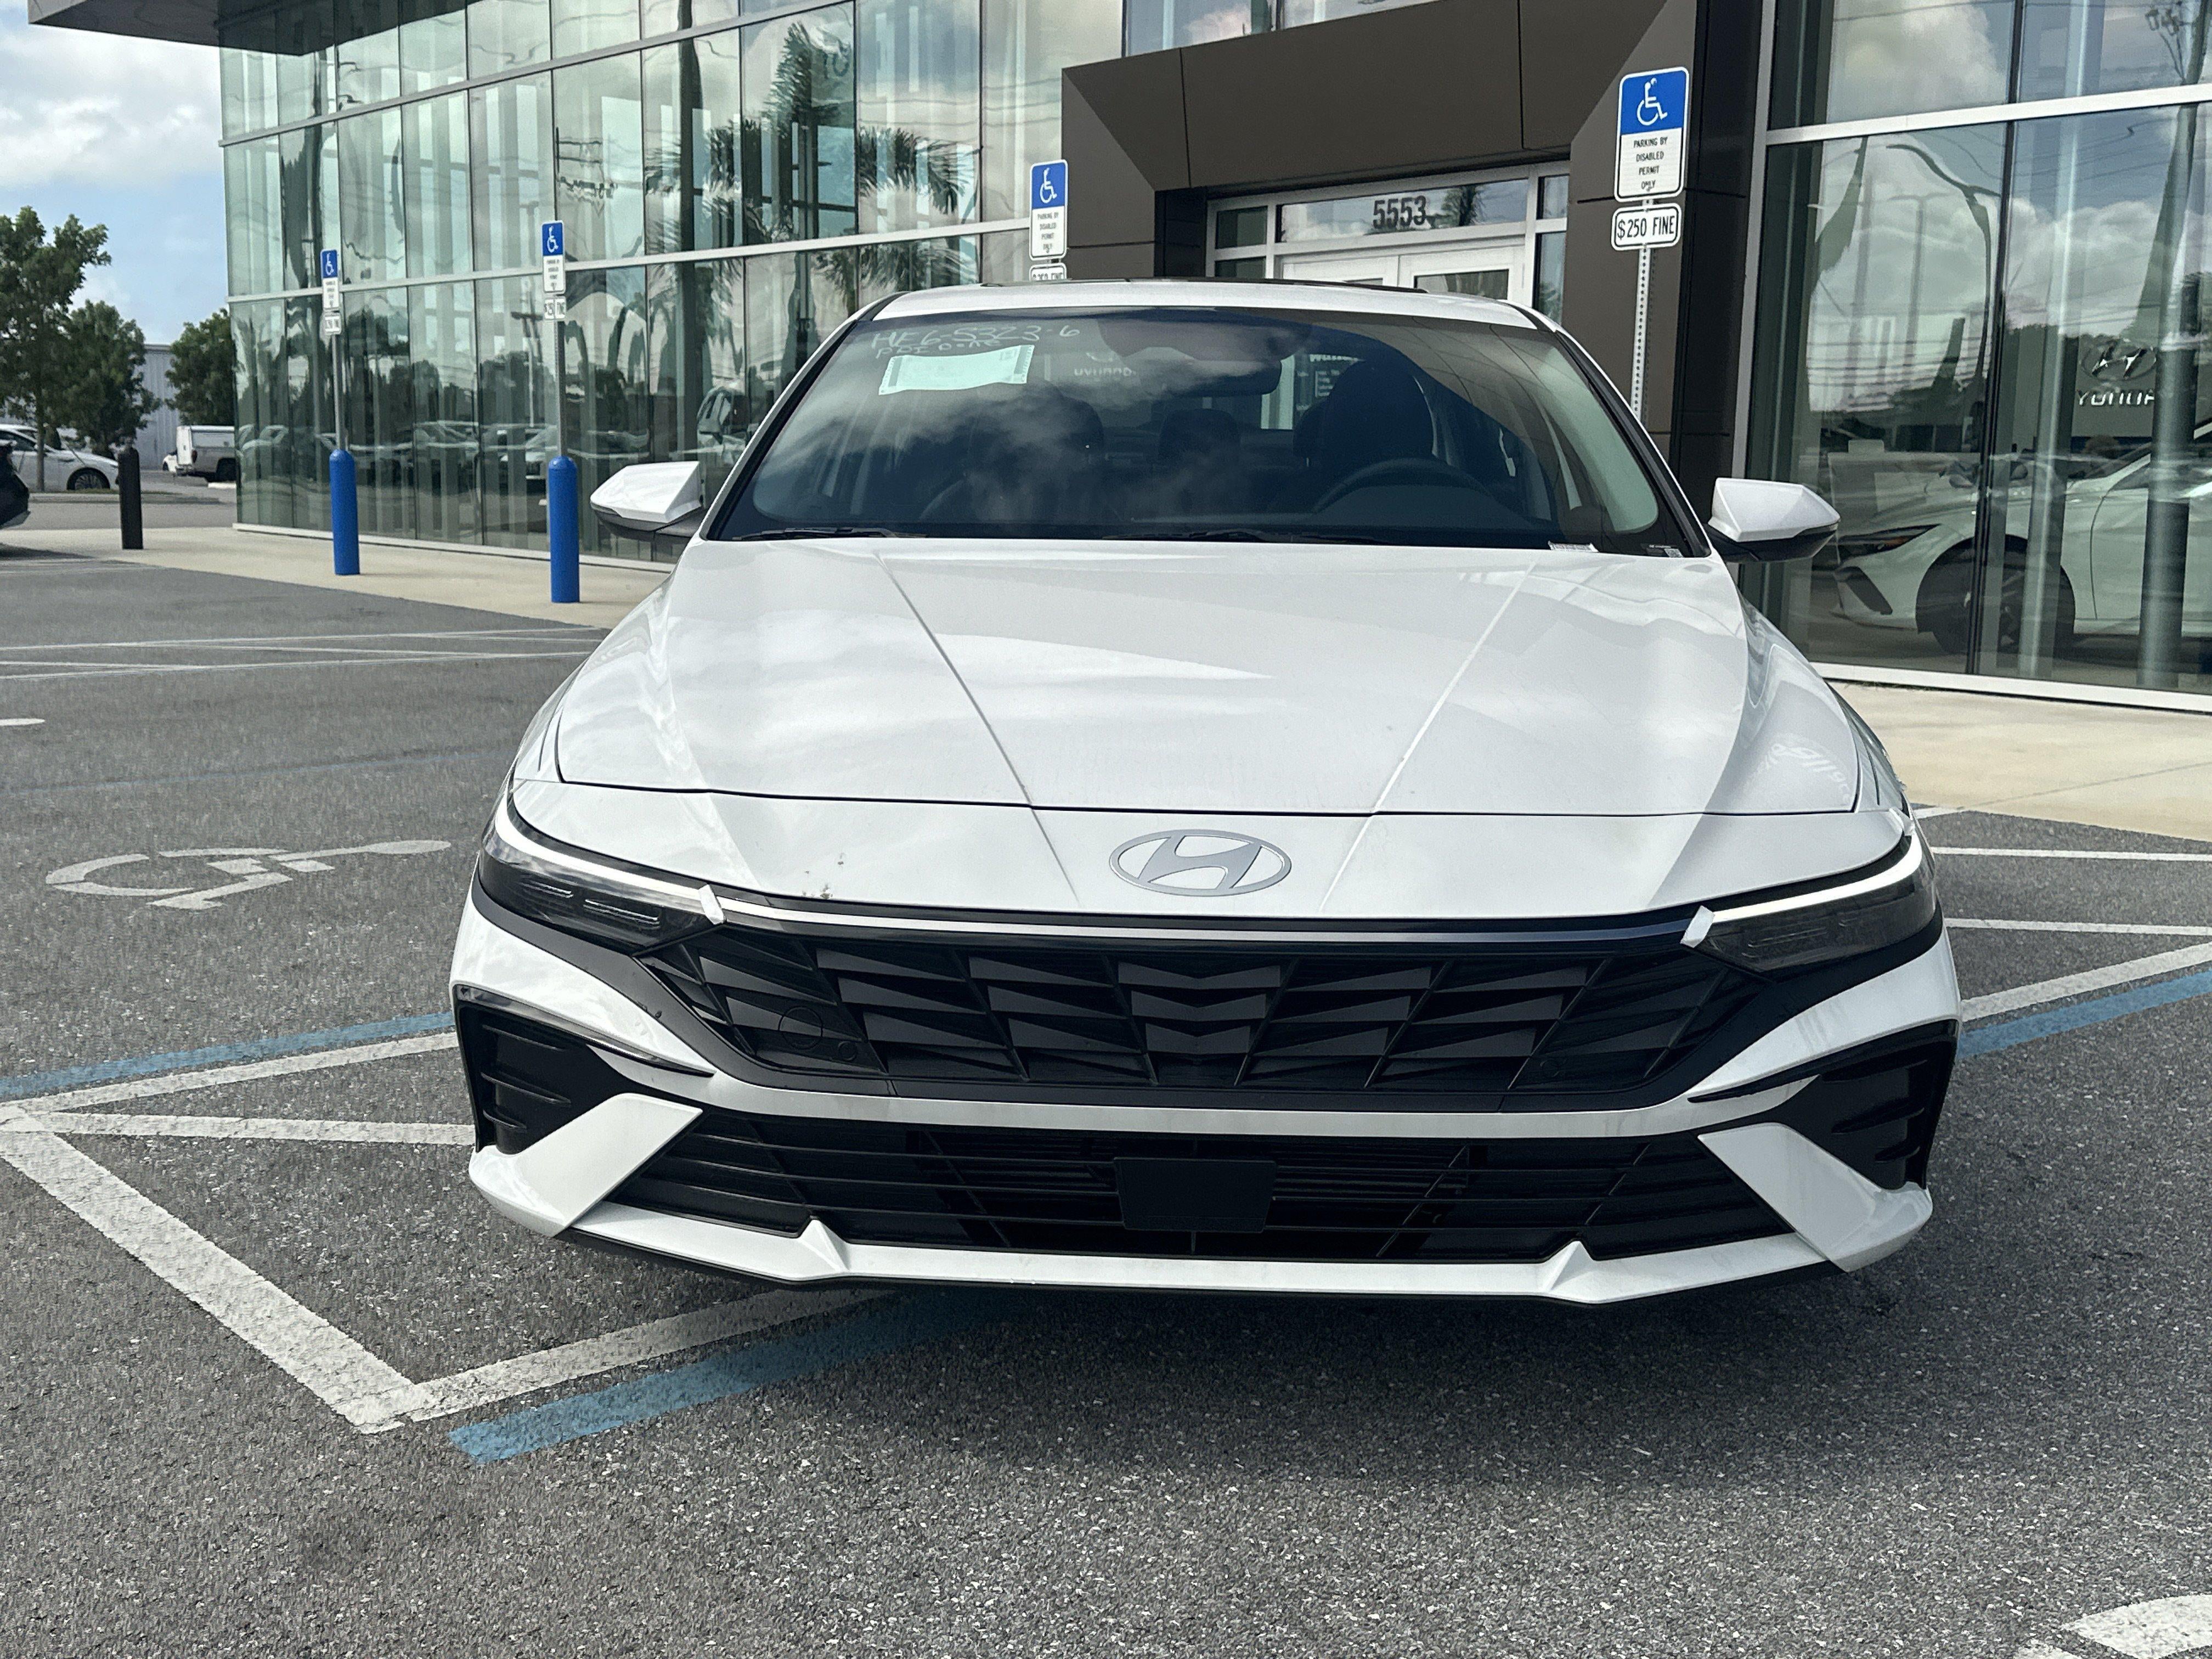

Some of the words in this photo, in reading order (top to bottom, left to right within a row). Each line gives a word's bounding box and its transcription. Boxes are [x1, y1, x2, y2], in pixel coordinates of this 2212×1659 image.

[1633, 137, 1658, 148] PARKING
[1660, 136, 1668, 145] BY
[1636, 151, 1664, 162] DISABLED
[1639, 165, 1660, 176] PERMIT
[1373, 195, 1426, 229] 5553
[1617, 218, 1647, 240] $250
[1652, 216, 1675, 235] FINE
